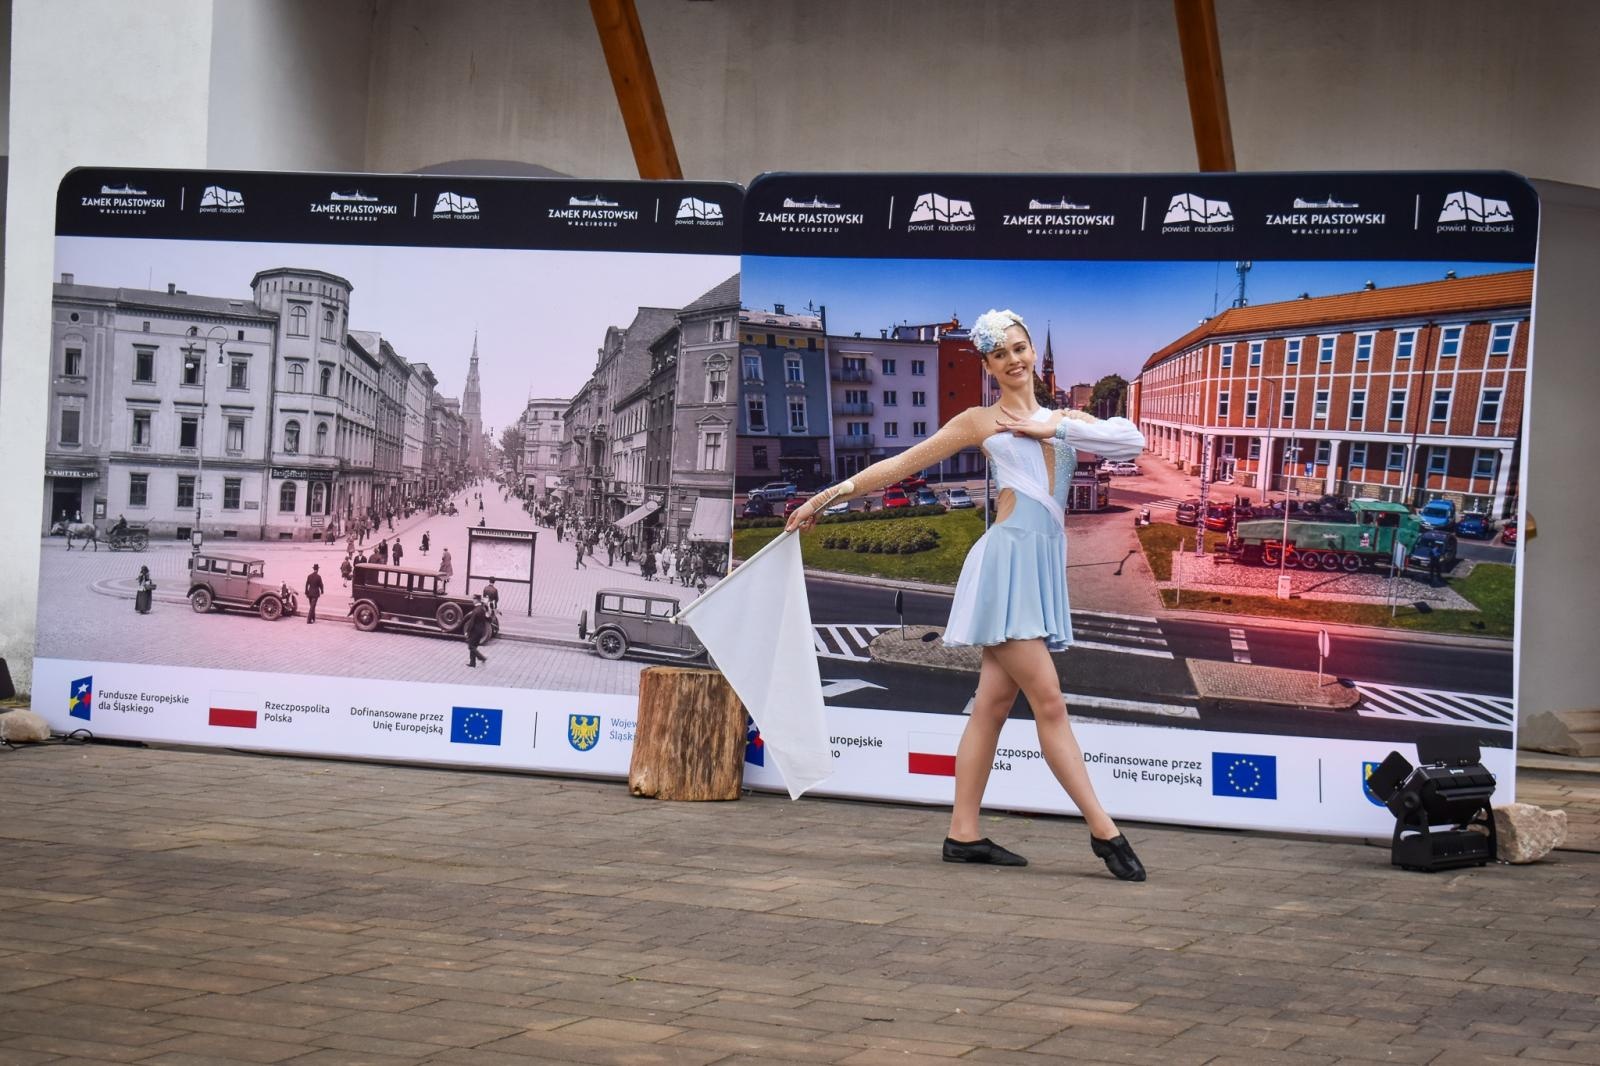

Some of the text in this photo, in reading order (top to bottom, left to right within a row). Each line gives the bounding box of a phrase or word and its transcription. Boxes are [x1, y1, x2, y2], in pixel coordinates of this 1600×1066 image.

[81, 197, 165, 208] ZAMEK PIASTOWSKI
[310, 204, 397, 215] ZAMEK PIASTOWSKI
[548, 208, 638, 220] ZAMEK PIASTOWSKI
[758, 212, 863, 224] ZAMEK PIASTOWSKI
[1003, 215, 1115, 227] ZAMEK PIASTOWSKI
[1266, 213, 1385, 225] ZAMEK PIASTOWSKI
[908, 223, 975, 232] powiat raciborski
[1162, 224, 1234, 234] powiat raciborski
[1437, 224, 1514, 233] powiat raciborski
[99, 690, 189, 706] Fundusze Europejskie
[98, 700, 154, 715] dla Śląskiego
[265, 701, 330, 715] Rzeczpospolita
[264, 713, 292, 723] Polska
[350, 707, 444, 722] Dofinansowane przez
[373, 720, 444, 735] Unię Europejską
[830, 735, 883, 748] uropejskie
[992, 760, 1012, 771] ska
[1084, 753, 1202, 772] Dofinansowane przez
[1113, 769, 1202, 787] Unię Europejską
